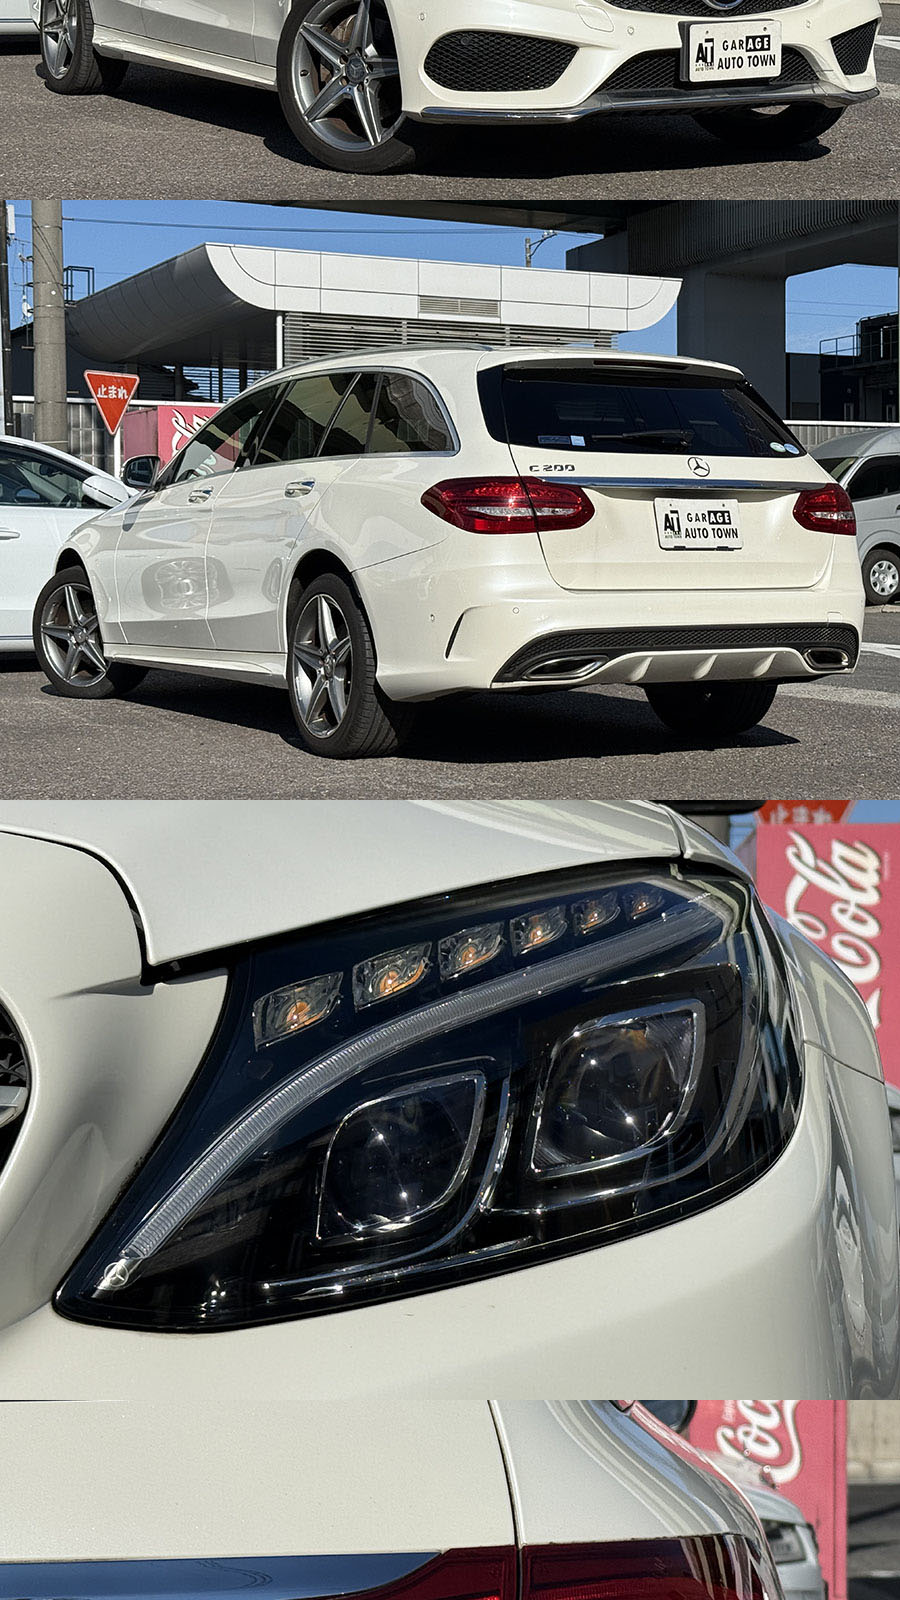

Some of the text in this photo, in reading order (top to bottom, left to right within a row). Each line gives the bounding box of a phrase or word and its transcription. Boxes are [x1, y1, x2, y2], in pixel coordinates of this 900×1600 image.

[722, 36, 770, 51] GARAGE
[717, 54, 776, 70] AUTO TOWN
[96, 384, 129, 400] 止まれ
[529, 464, 576, 472] C 200
[686, 511, 731, 523] GARAGE
[685, 527, 708, 539] AUTO
[711, 527, 739, 539] TOWN
